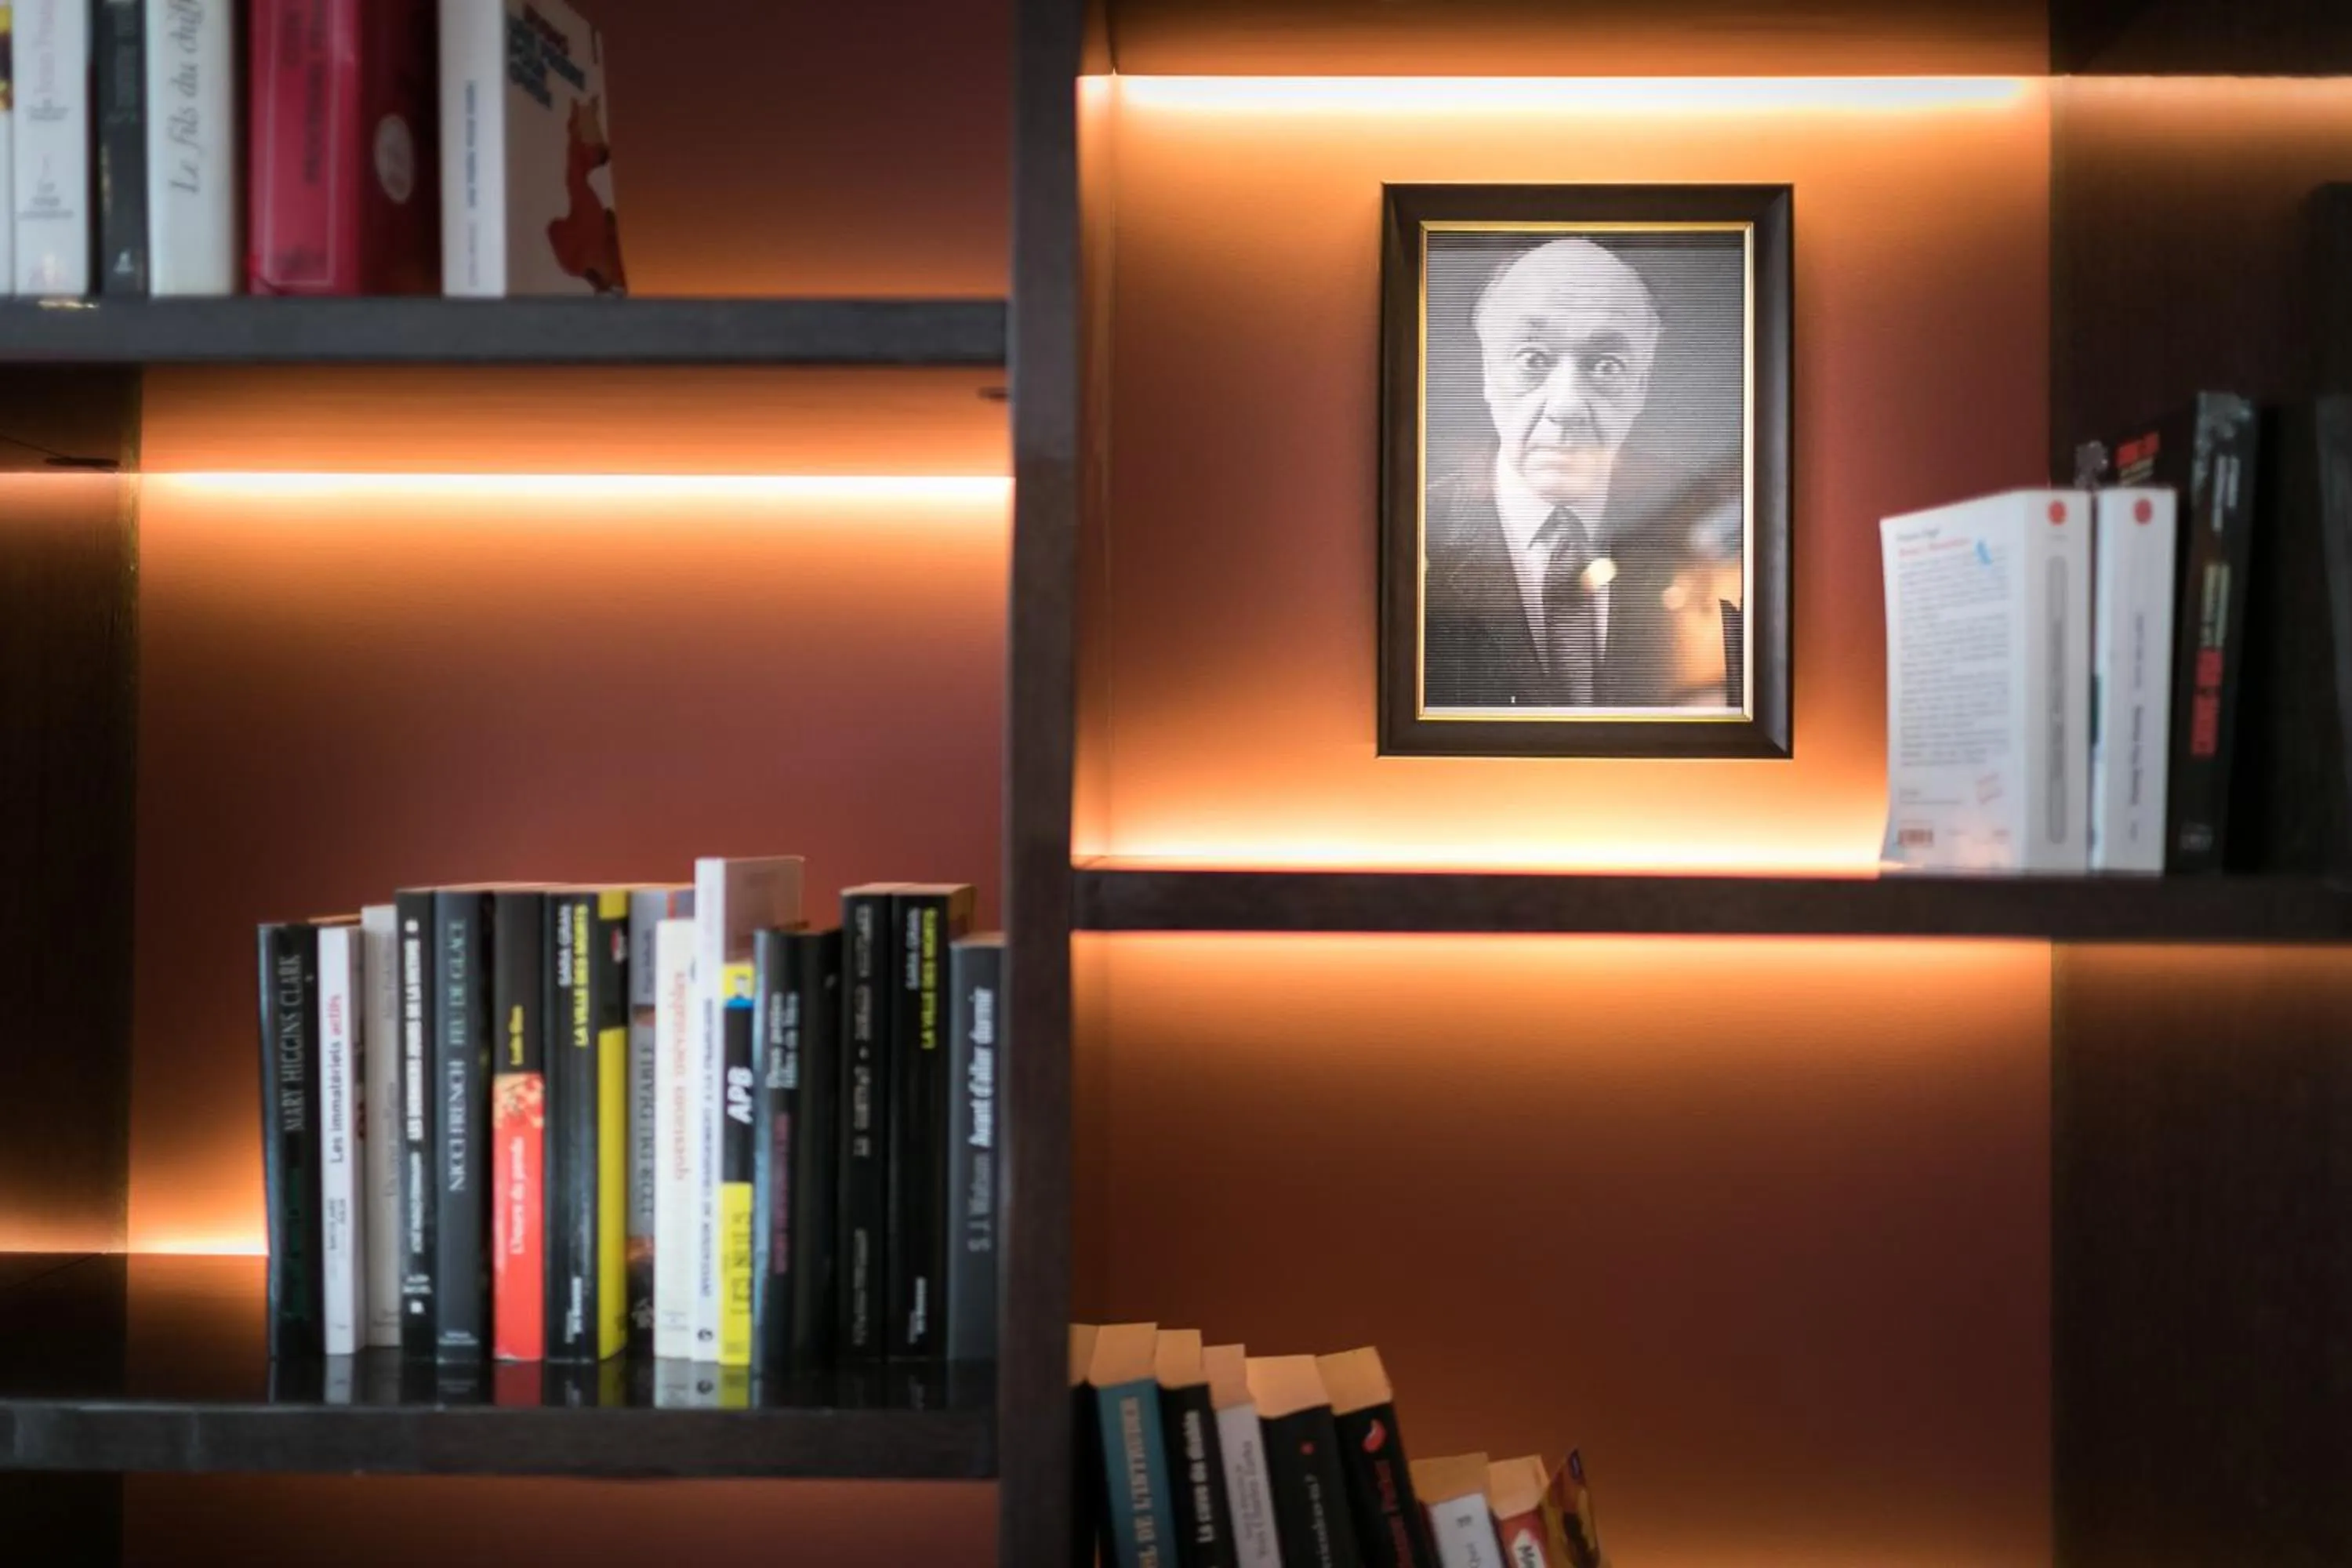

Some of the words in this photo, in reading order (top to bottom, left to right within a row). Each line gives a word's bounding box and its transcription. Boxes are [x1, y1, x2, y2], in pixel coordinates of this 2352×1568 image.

[277, 953, 303, 1007] CLARK
[573, 988, 590, 1025] VILLE
[278, 1011, 303, 1083] HIGGINS
[574, 1028, 590, 1047] LA
[920, 1029, 937, 1049] LA
[325, 1040, 344, 1132] immatériels
[447, 1058, 466, 1134] FRENCH
[727, 1067, 752, 1124] APB
[281, 1089, 305, 1132] MARY
[969, 1099, 993, 1147] Avant
[328, 1136, 345, 1164] Les
[447, 1138, 467, 1192] NICCI
[1134, 1515, 1156, 1542] DE
